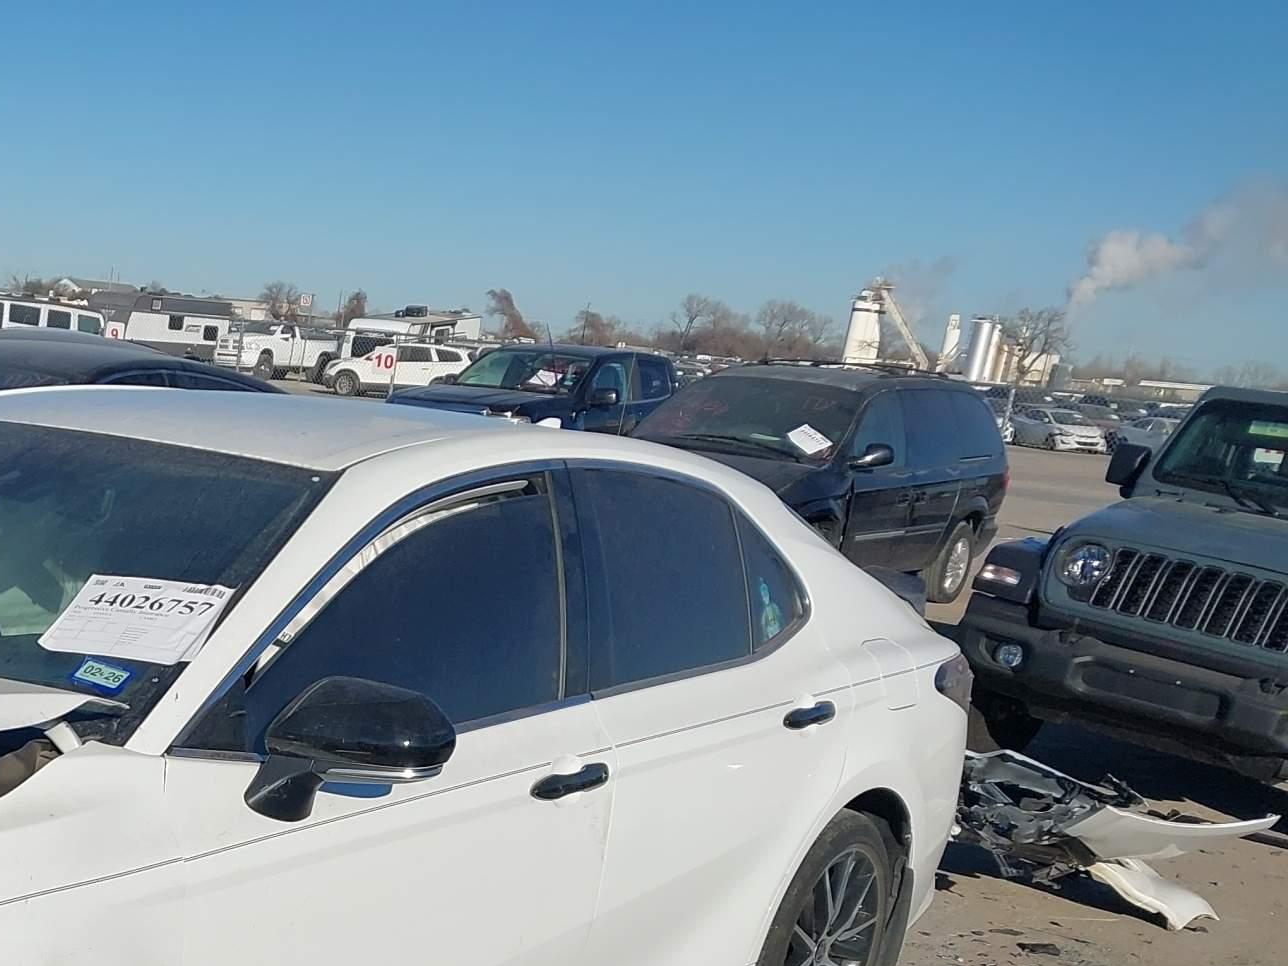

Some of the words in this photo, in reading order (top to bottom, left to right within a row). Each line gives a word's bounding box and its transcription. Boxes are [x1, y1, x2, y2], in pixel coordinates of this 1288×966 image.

[111, 328, 119, 340] 9
[375, 353, 394, 369] 10
[88, 592, 215, 617] 44026757
